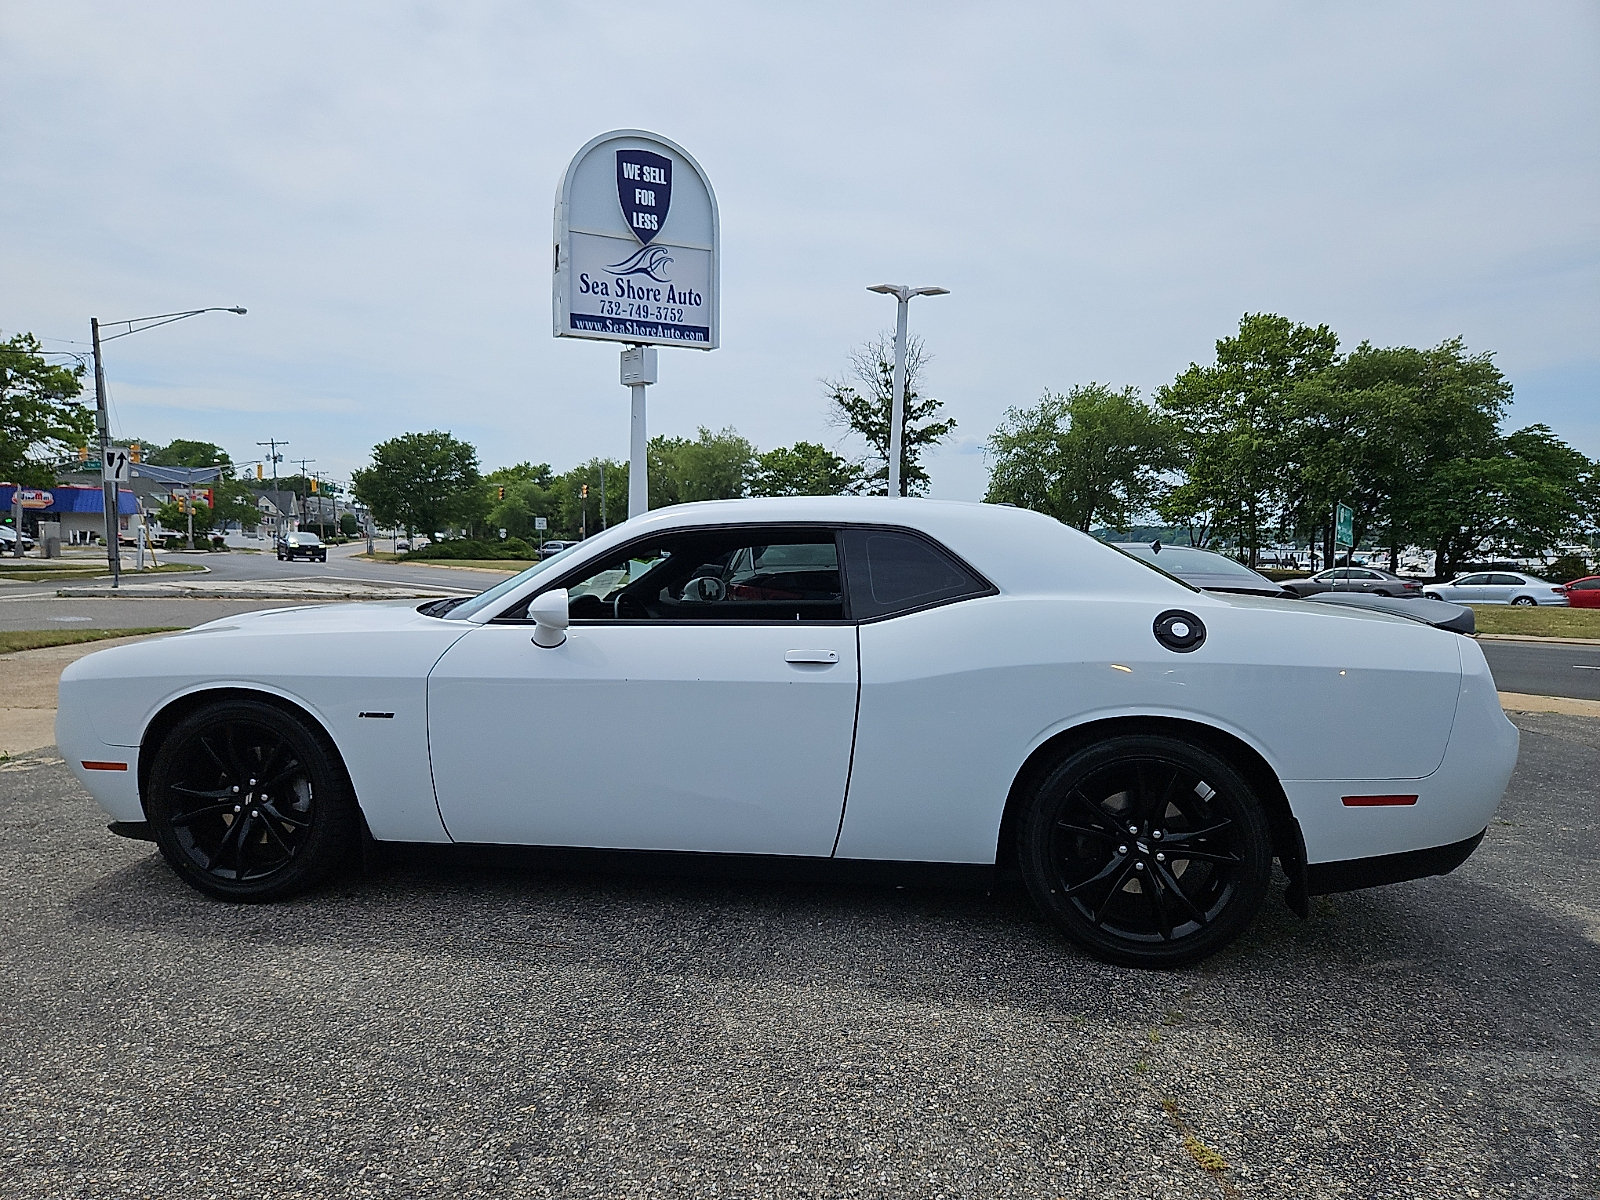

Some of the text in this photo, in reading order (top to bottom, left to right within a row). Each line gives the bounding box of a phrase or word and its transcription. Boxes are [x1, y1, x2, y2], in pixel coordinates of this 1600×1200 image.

[623, 162, 667, 185] WE SELL
[635, 188, 655, 207] FOR
[632, 211, 658, 231] LESS
[580, 273, 702, 306] Sea Shore Auto
[600, 300, 684, 323] 732-749-3752
[575, 319, 704, 342] www.SeaShoreAuto.com
